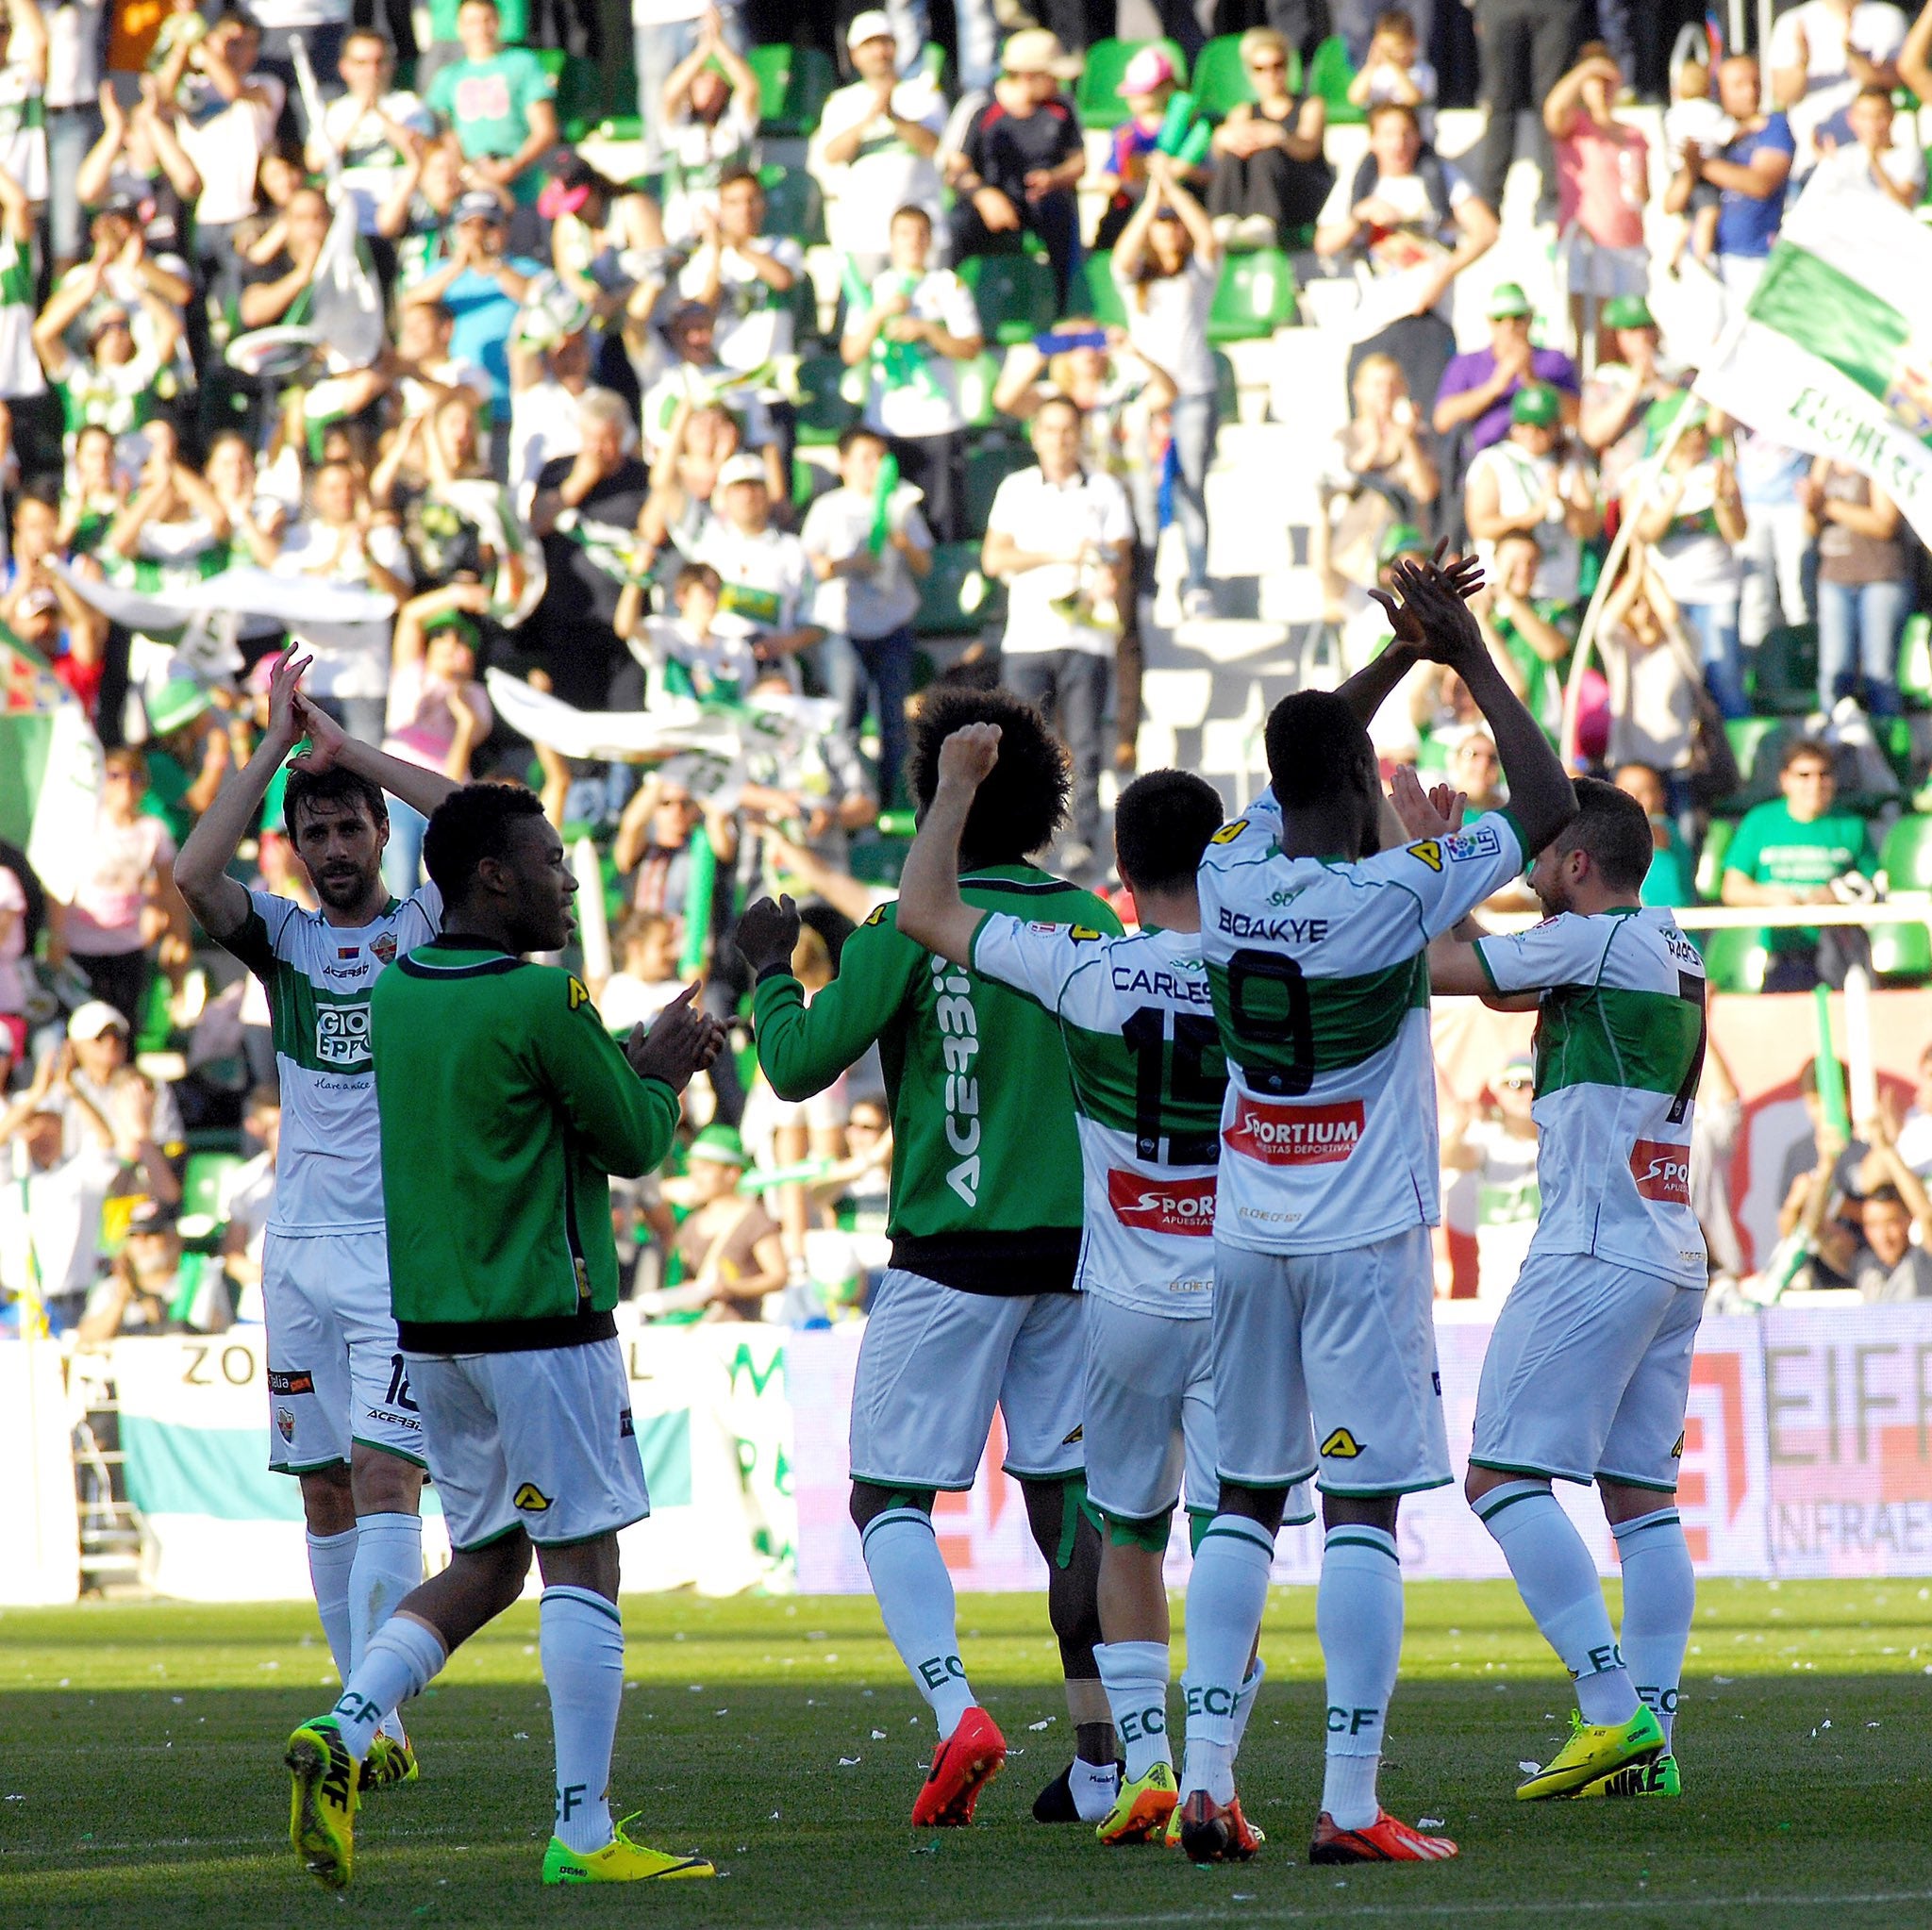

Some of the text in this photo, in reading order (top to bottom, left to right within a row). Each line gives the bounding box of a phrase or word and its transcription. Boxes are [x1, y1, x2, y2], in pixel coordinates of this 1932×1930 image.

[1219, 907, 1328, 943] BOAKYE
[1112, 967, 1213, 1005] CARLES
[1227, 948, 1315, 1096] 9
[1121, 1006, 1225, 1166] 15
[1236, 1112, 1358, 1144] SPORTIUM
[1637, 1156, 1689, 1183] SPO
[1117, 1191, 1215, 1217] SPOR
[1327, 1705, 1379, 1736] CF
